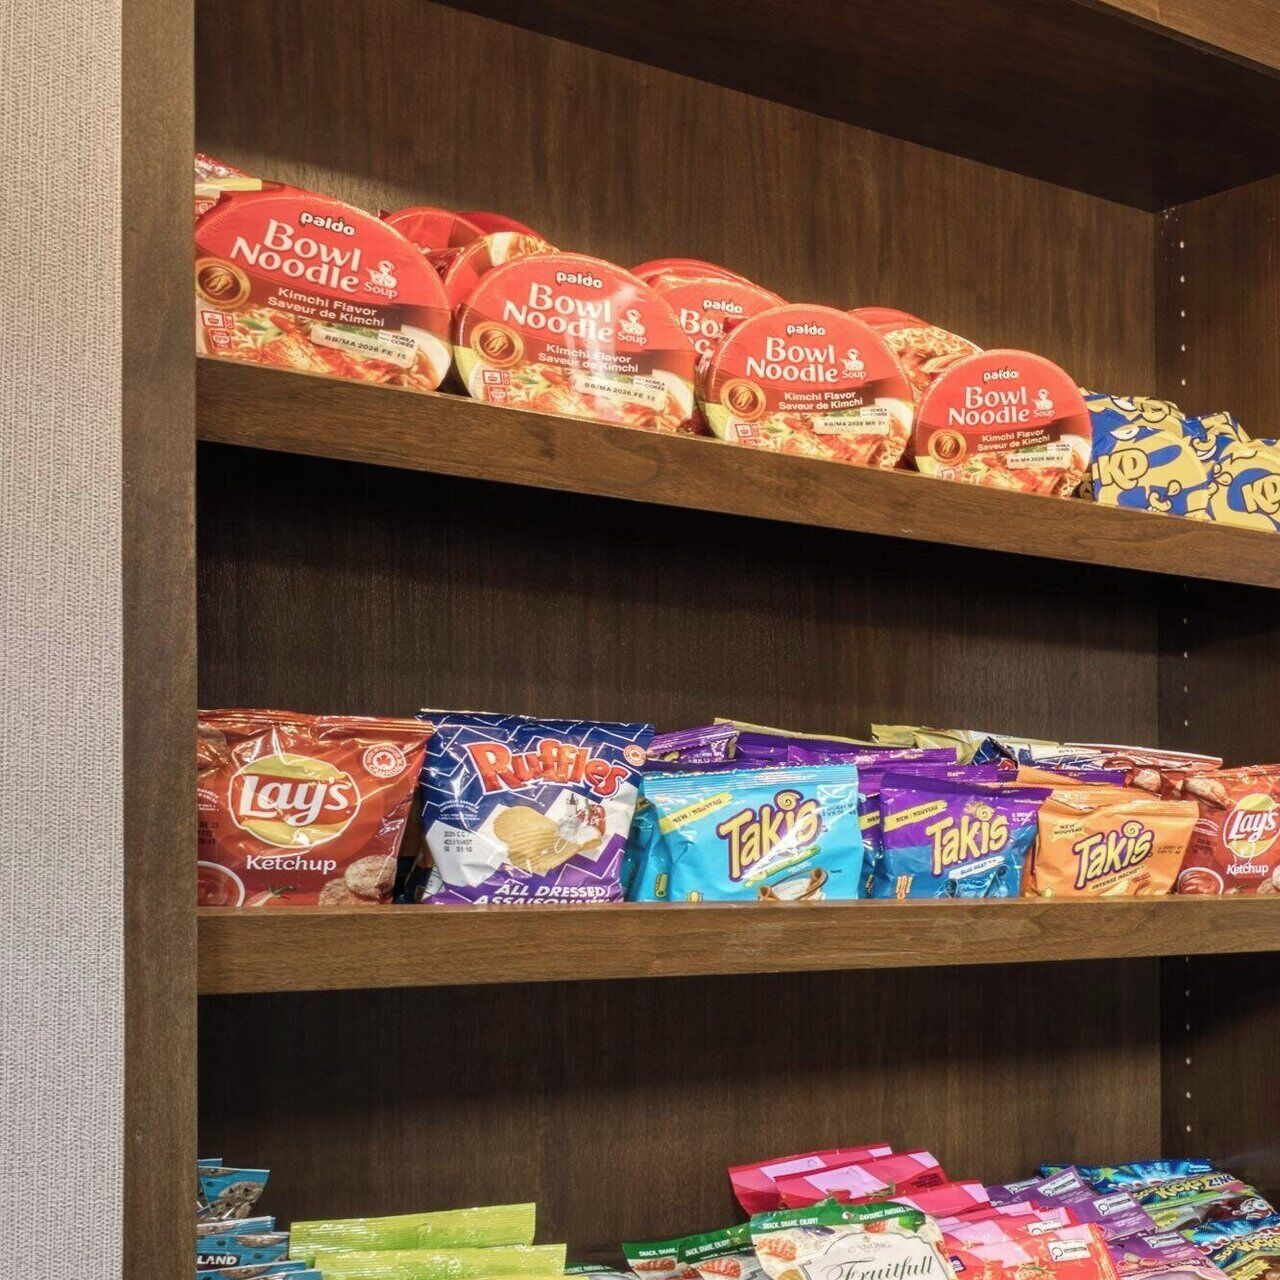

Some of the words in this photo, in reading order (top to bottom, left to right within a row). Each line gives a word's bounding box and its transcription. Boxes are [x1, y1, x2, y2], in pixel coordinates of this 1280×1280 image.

[300, 211, 356, 236] paldo
[264, 219, 362, 272] Bowl
[229, 236, 360, 293] Noodle
[364, 282, 397, 299] Soup
[557, 271, 604, 289] paldo
[268, 297, 315, 315] Saveur
[319, 309, 336, 319] de
[340, 313, 385, 327] Kimchi
[278, 288, 329, 307] Kimchi
[333, 301, 378, 317] Flavor
[530, 282, 612, 323] Bowl
[503, 300, 614, 343] Noodle
[617, 332, 648, 345] Soup
[538, 353, 579, 367] Saveur
[600, 362, 638, 373] Kimchi
[547, 343, 588, 359] Kimchi
[766, 337, 836, 365] Bowl
[746, 356, 839, 383] Noodle
[842, 370, 867, 380] Soup
[779, 402, 813, 410] Saveur
[816, 402, 829, 410] de
[831, 398, 863, 409] Kimchi
[784, 392, 822, 401] Kimchi
[824, 392, 857, 400] Flavor
[965, 386, 1027, 409] Bowl
[948, 406, 1030, 425] Noodle
[982, 433, 1015, 442] Kimchi
[1017, 429, 1045, 438] Flavor
[1022, 435, 1051, 446] Kimchi
[1096, 448, 1148, 490] KD
[463, 739, 631, 798] Ruffles
[239, 775, 351, 827] Lay's
[717, 790, 822, 882] Takis
[1230, 806, 1279, 844] Lay's
[926, 804, 1009, 876] Takis
[246, 855, 337, 875] Ketchup
[1074, 820, 1155, 890] Takis
[1227, 863, 1269, 877] Ketchup
[495, 885, 532, 896] ALL
[535, 886, 606, 897] DRESSED
